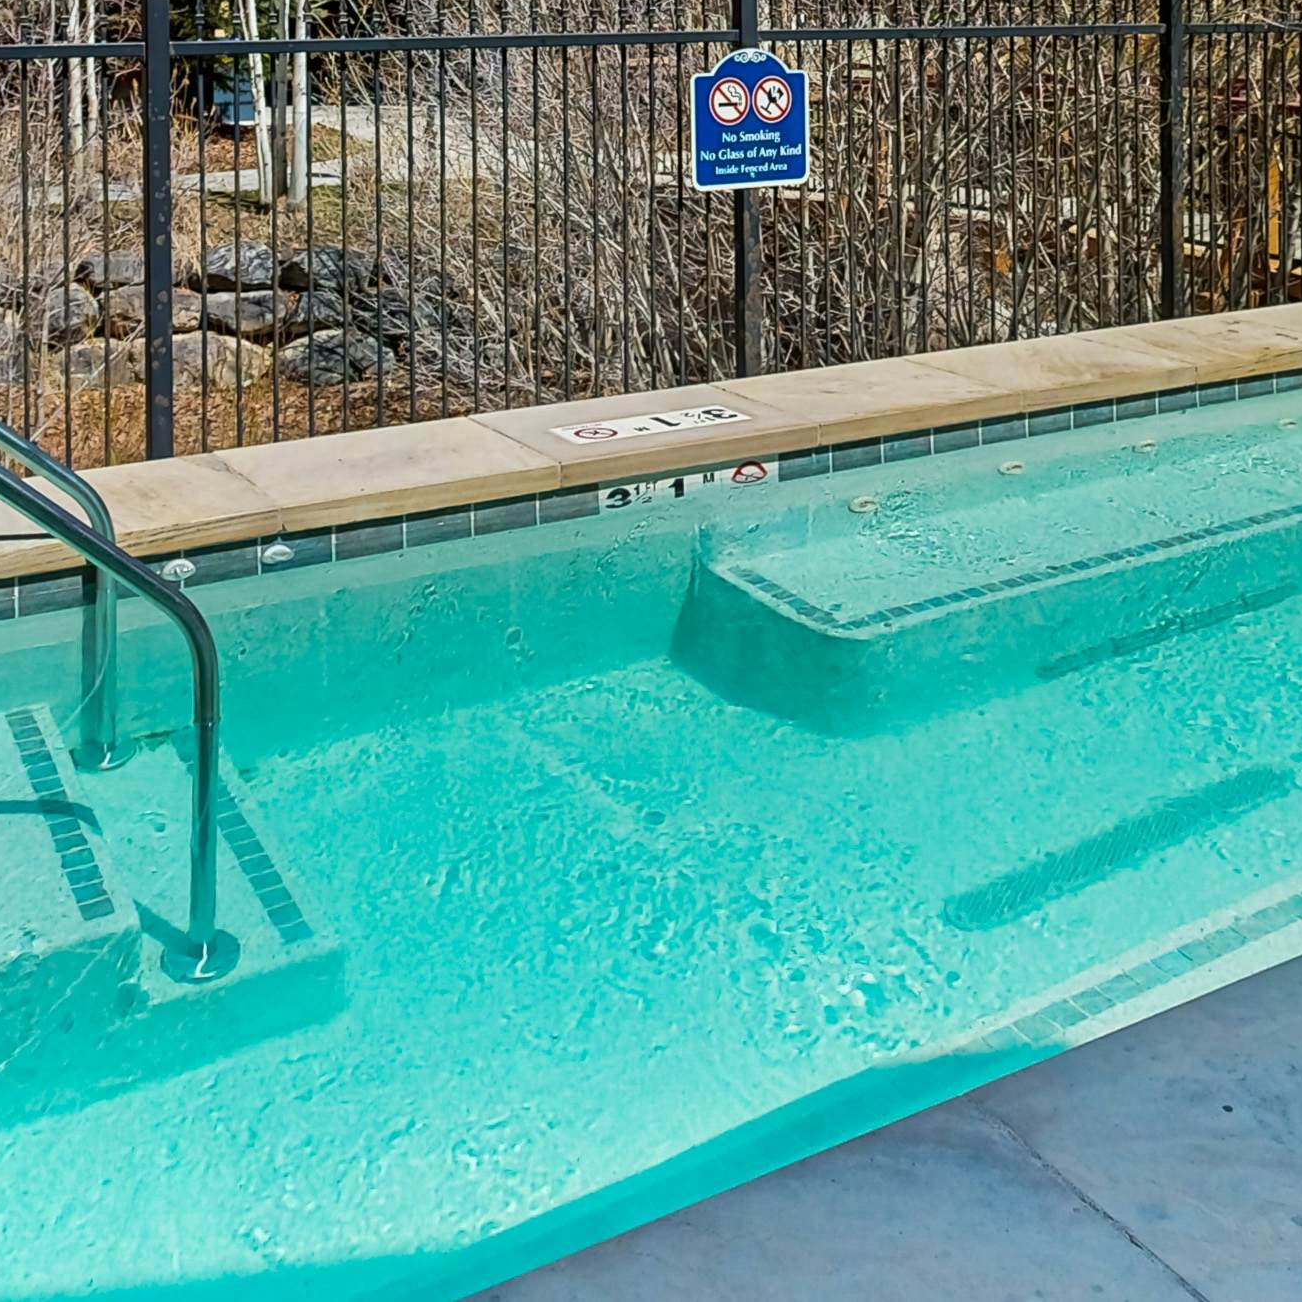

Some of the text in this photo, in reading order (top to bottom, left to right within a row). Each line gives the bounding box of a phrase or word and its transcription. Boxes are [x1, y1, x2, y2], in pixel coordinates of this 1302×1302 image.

[722, 129, 781, 144] No Smoking
[700, 143, 802, 161] No Glass of Any Kind
[715, 162, 788, 175] Inside Fenced Area
